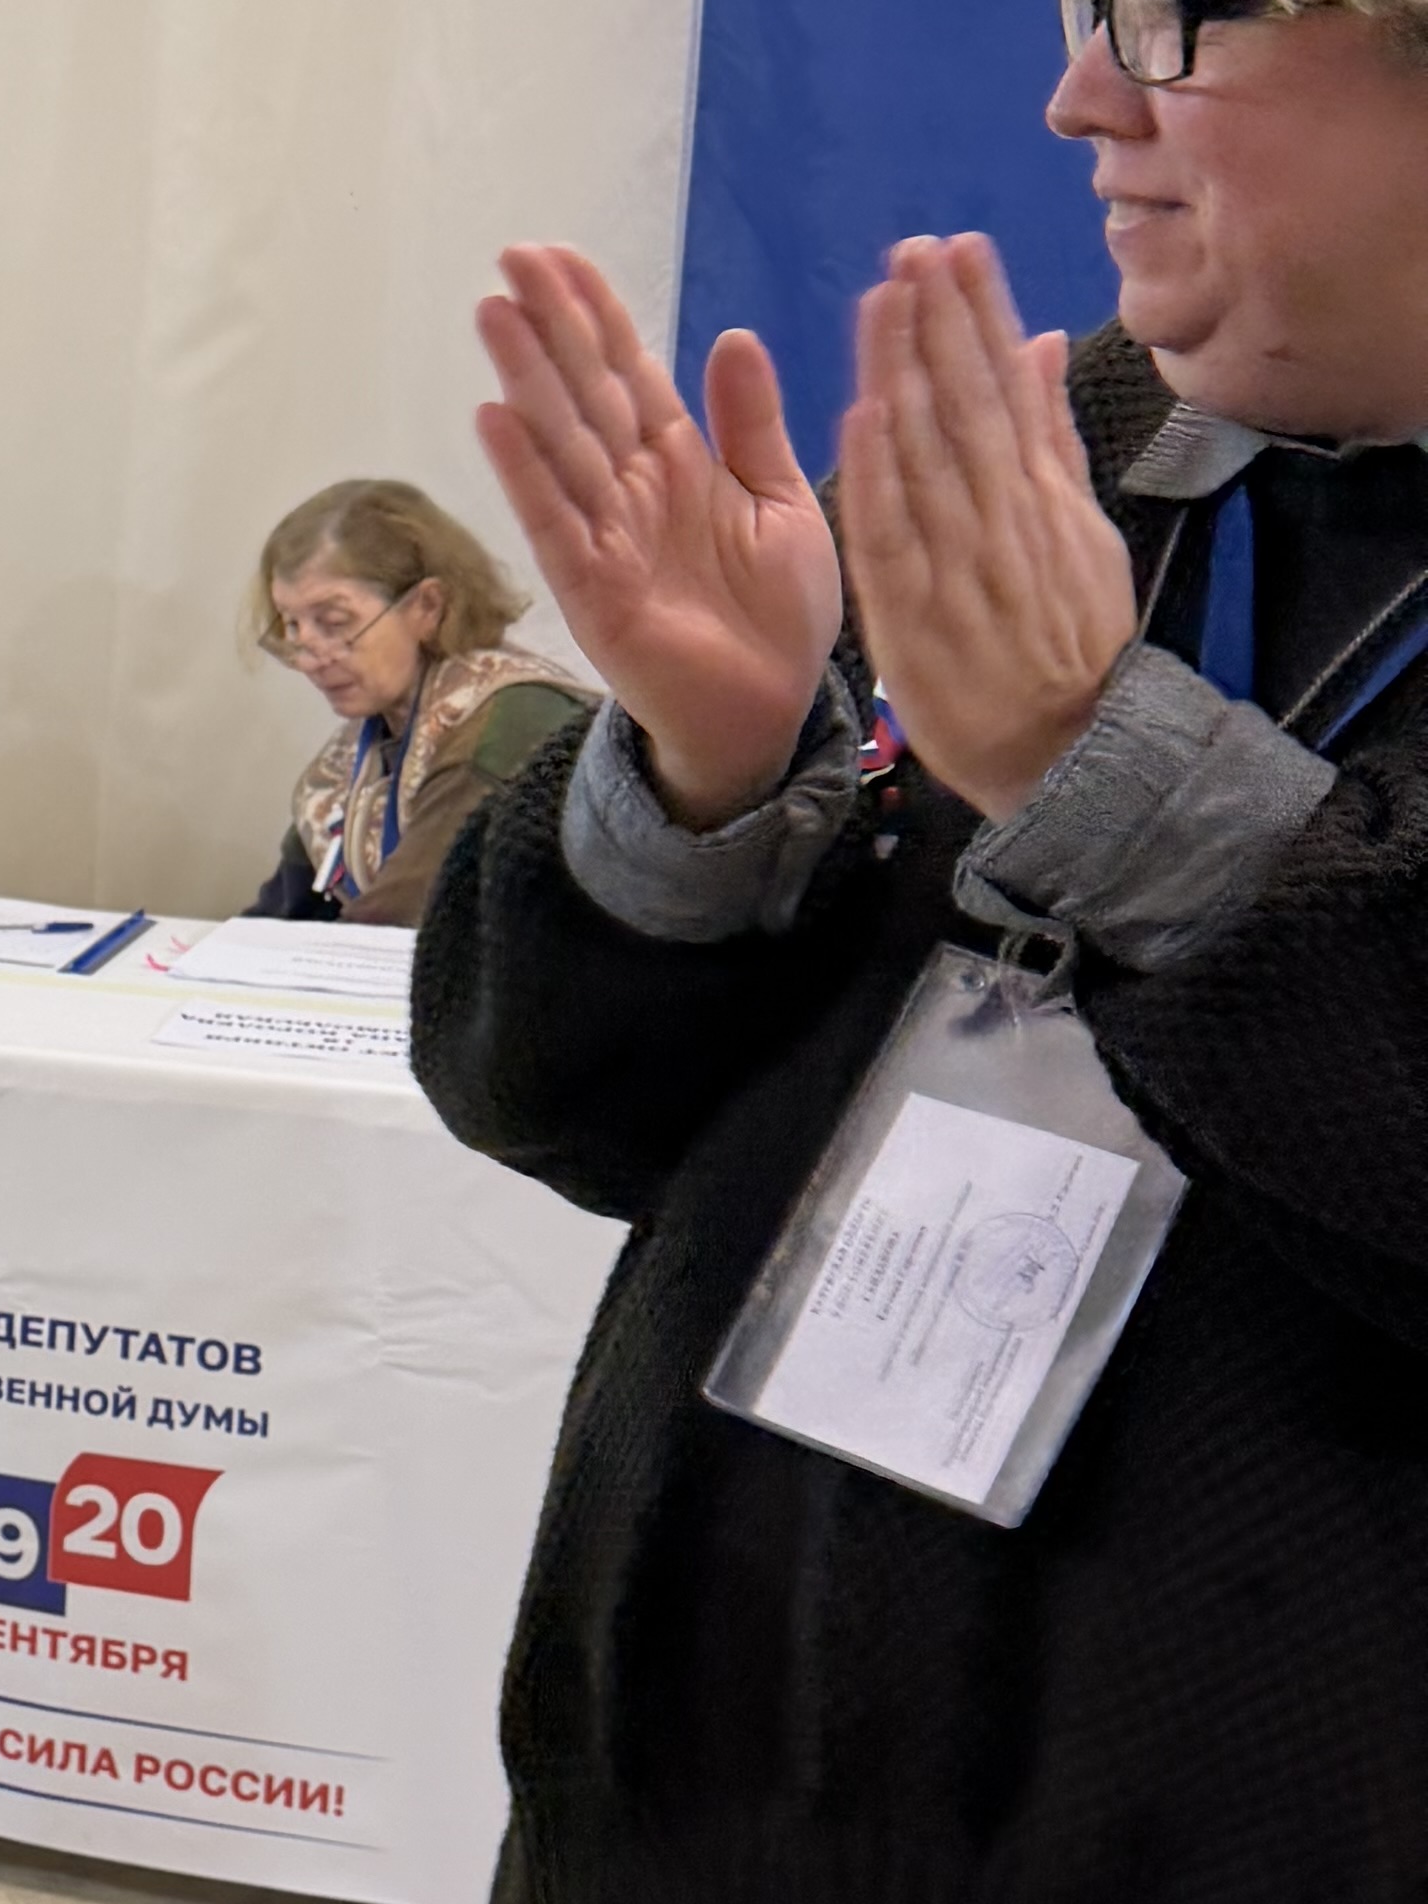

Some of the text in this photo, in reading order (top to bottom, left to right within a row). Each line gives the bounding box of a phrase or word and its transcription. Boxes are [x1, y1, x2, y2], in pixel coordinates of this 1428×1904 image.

[146, 1397, 270, 1439] ДУМЫ
[62, 1483, 183, 1567] 20
[133, 1753, 347, 1817] РОССИИ!
